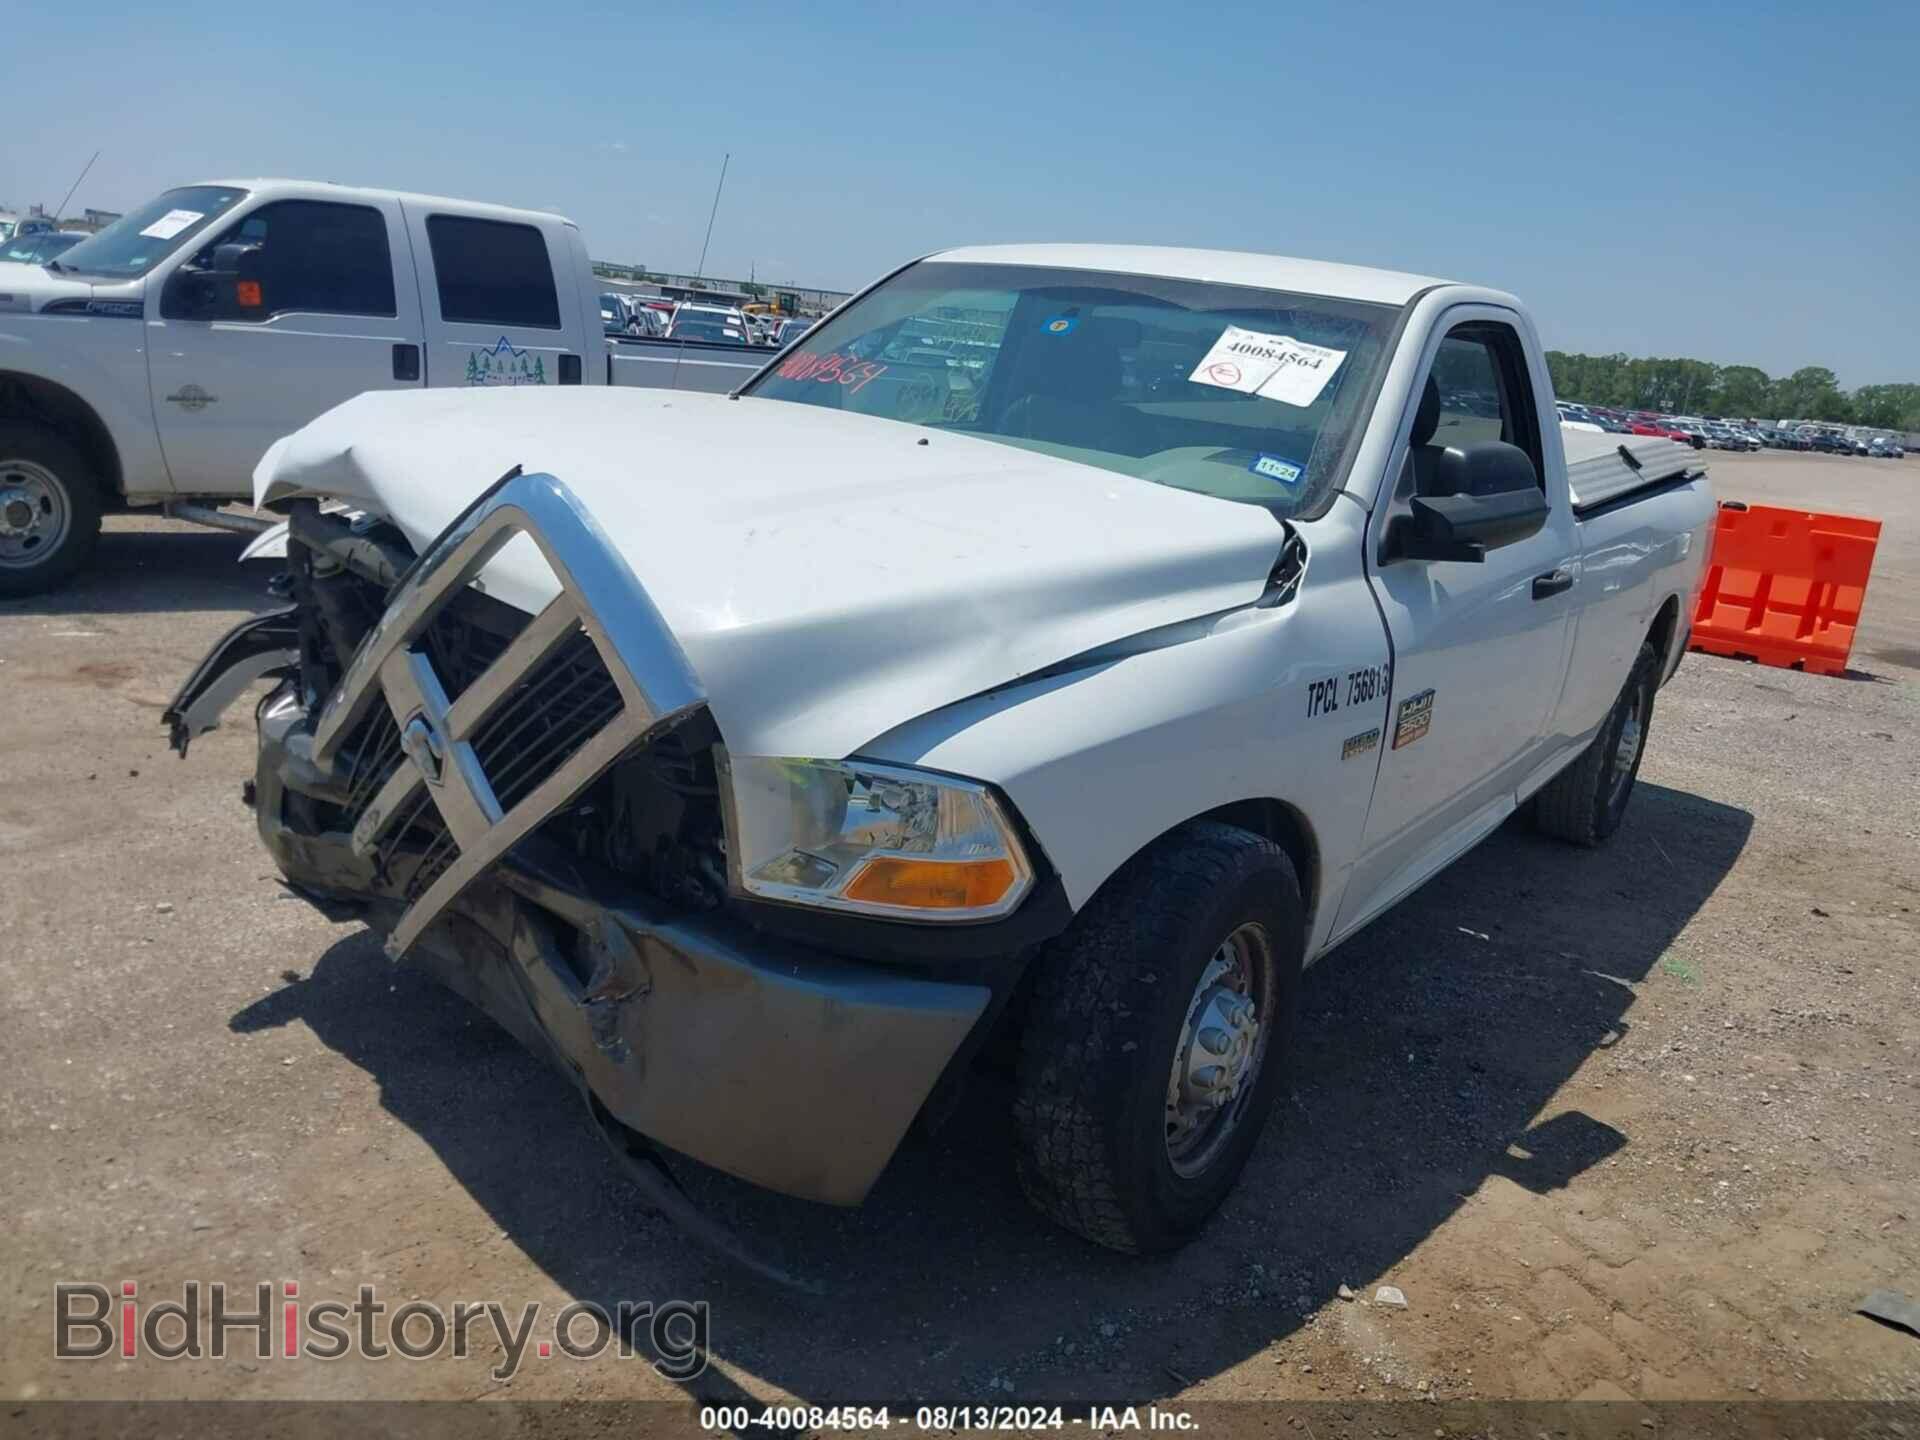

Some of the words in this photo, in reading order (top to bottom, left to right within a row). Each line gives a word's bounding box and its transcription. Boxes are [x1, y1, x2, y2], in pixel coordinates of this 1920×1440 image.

[1226, 340, 1323, 371] 40084564
[1307, 677, 1339, 719] TPCL
[1345, 663, 1389, 706] 756813
